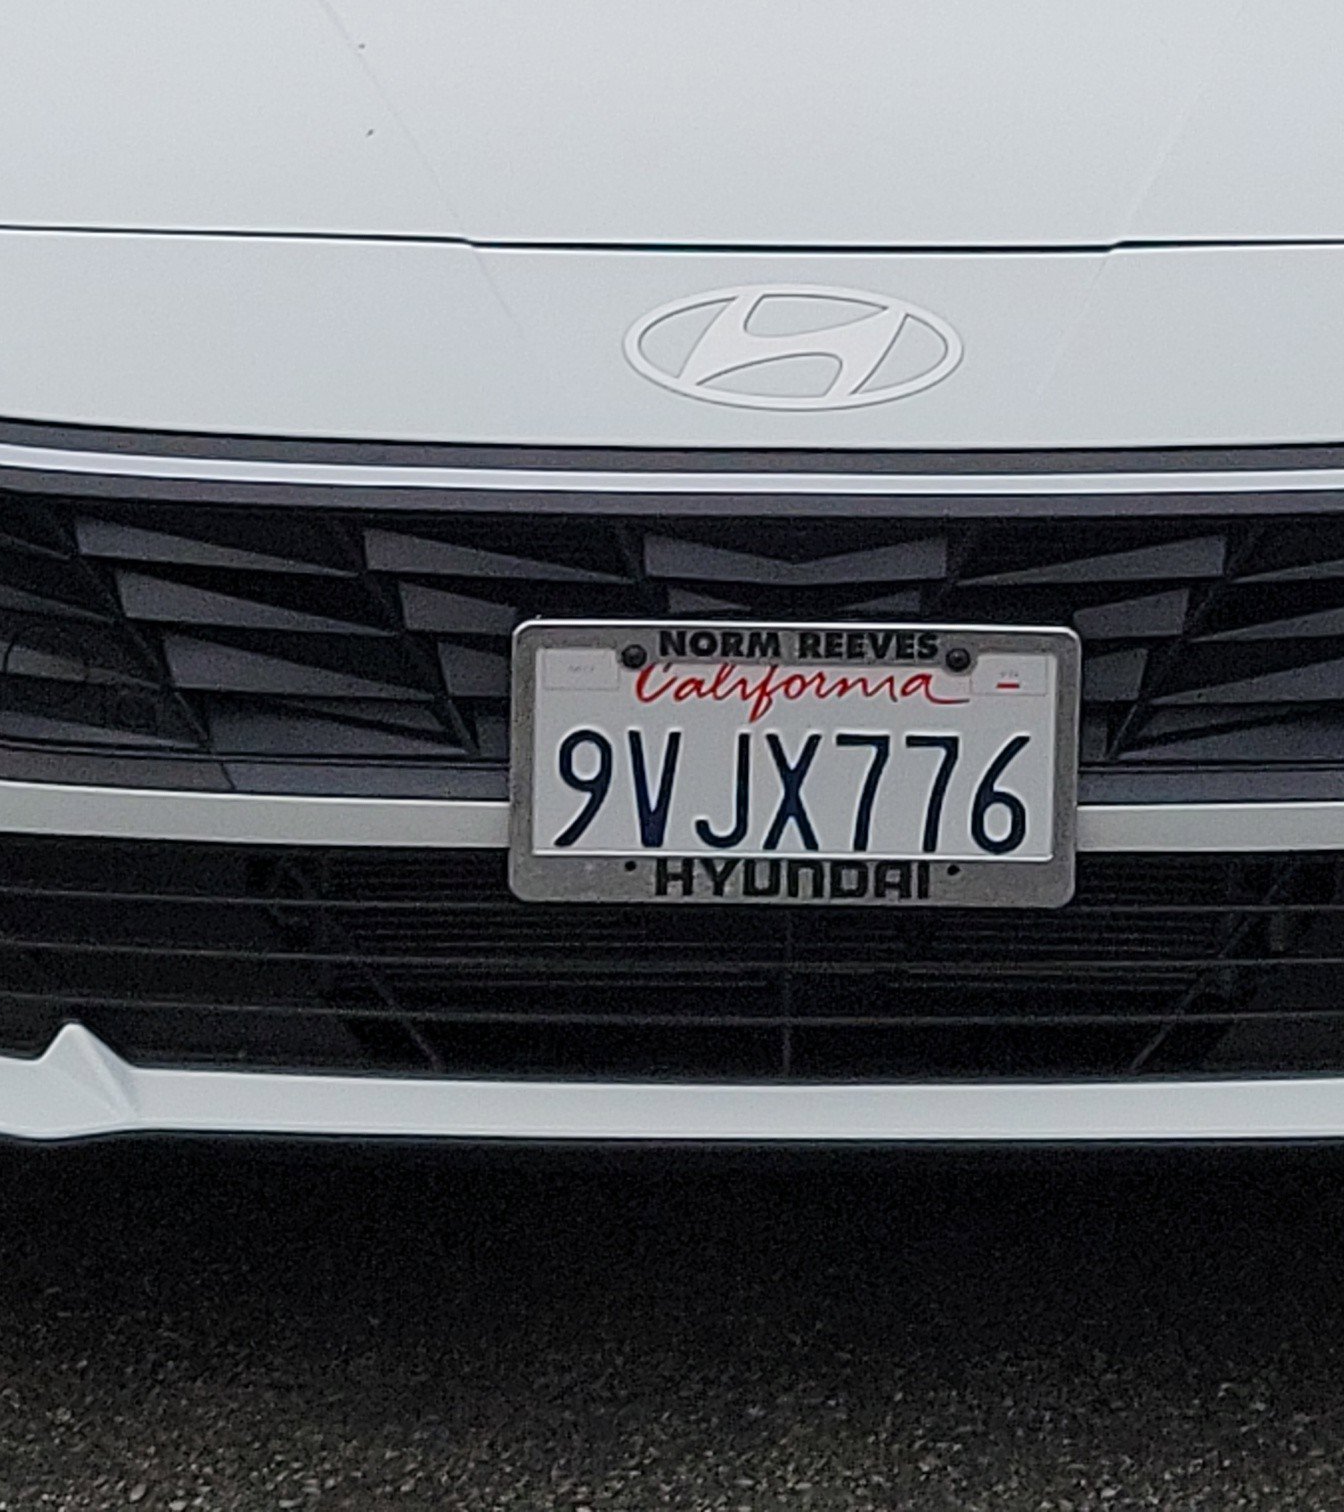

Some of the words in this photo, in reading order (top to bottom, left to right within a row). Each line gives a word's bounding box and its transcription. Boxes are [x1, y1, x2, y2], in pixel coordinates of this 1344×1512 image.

[659, 630, 781, 659] NORM
[799, 631, 939, 660] REEVES
[636, 663, 970, 723] California
[554, 729, 1031, 855] 9VJX776
[655, 860, 931, 900] HYUNDAI
